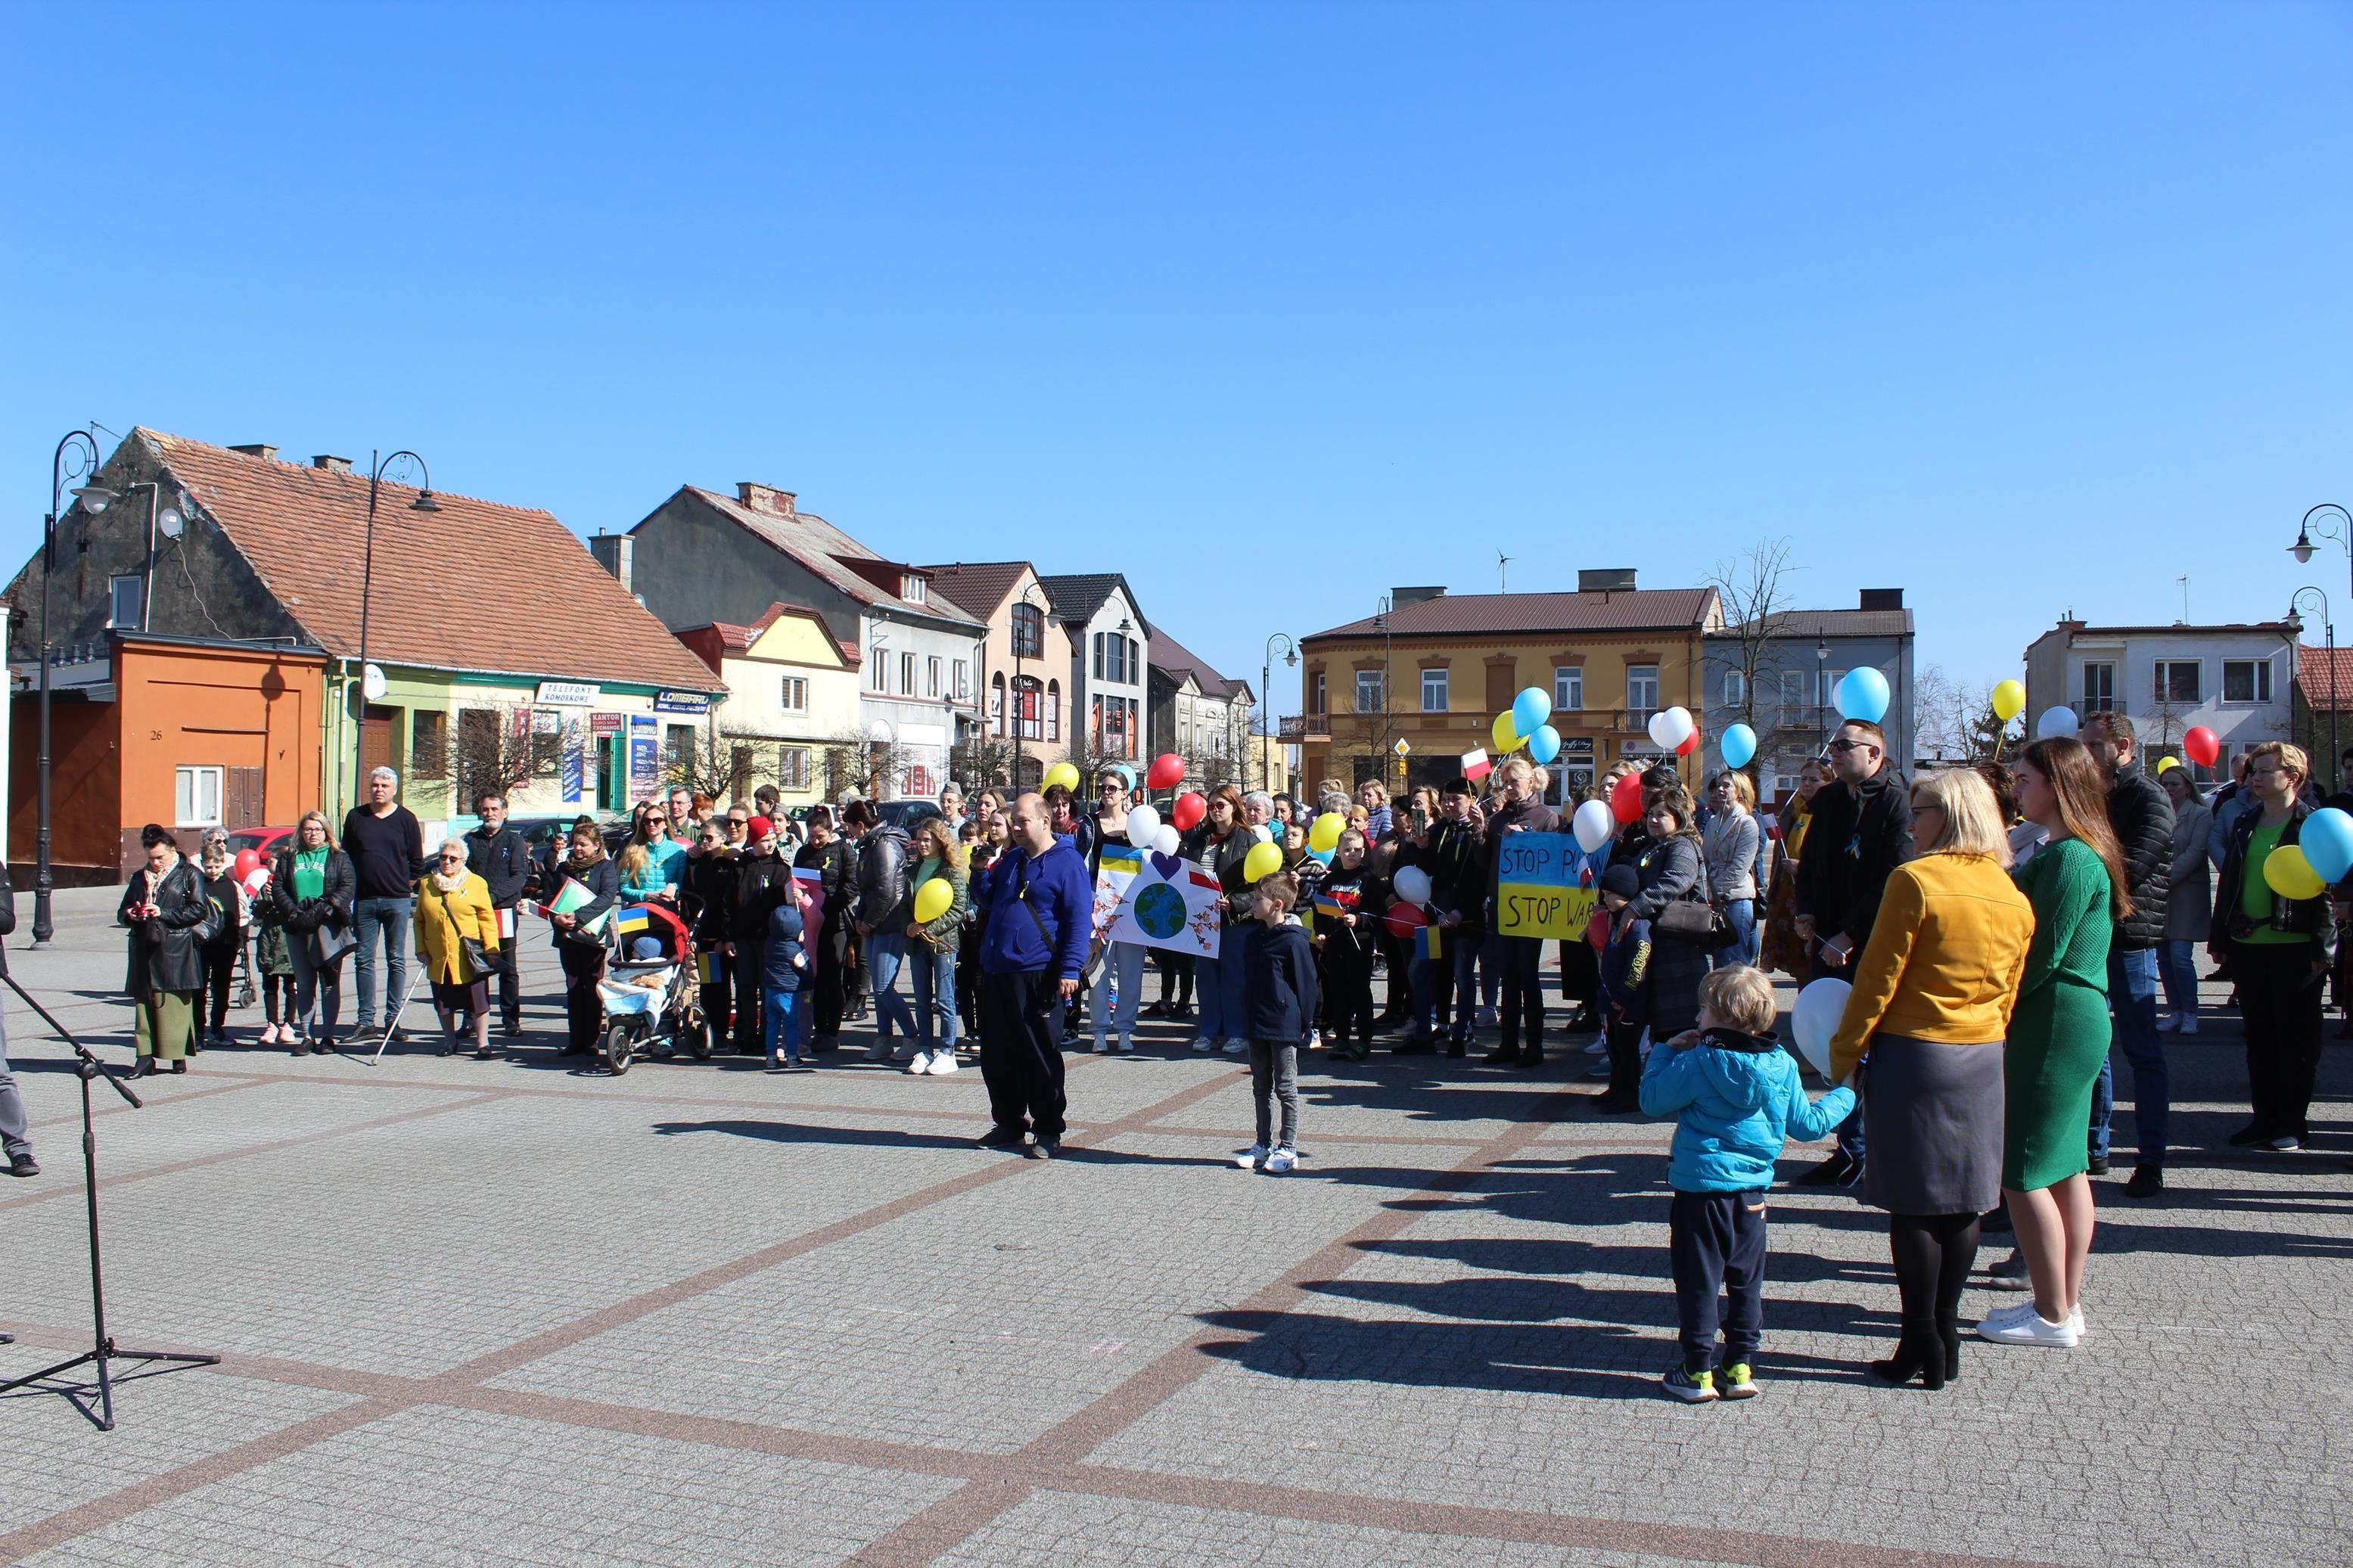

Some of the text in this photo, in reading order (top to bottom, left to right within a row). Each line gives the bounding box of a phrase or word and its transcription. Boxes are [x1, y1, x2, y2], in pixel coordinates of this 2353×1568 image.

[548, 685, 592, 694] TELEFONY
[659, 691, 709, 704] LOMBARD
[151, 730, 163, 741] 26
[1501, 848, 1605, 878] STOP PUIN
[1505, 895, 1595, 927] STOP WAR
